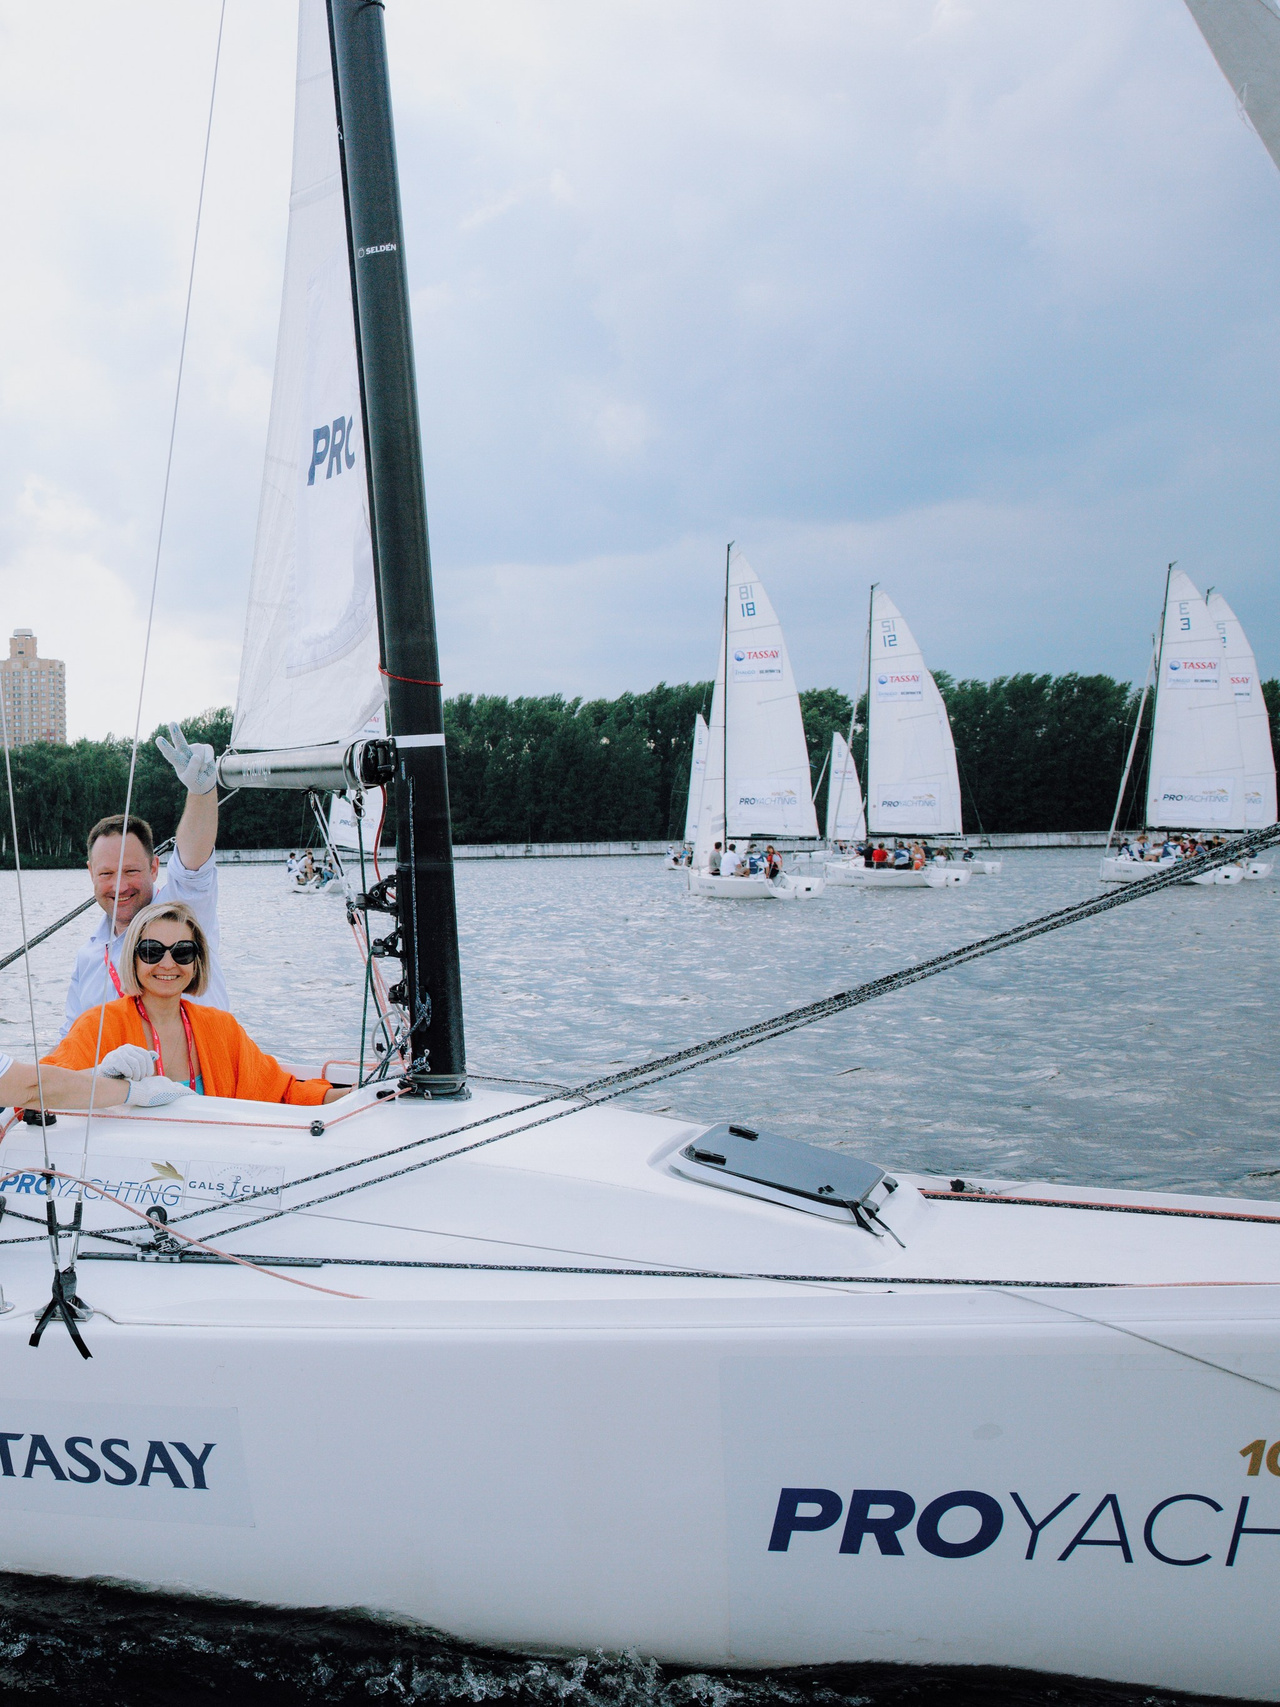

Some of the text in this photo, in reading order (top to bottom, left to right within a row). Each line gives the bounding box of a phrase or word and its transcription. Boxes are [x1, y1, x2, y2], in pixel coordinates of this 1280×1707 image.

[741, 602, 756, 617] 18
[1180, 617, 1190, 630] 3
[883, 634, 897, 647] 12
[747, 650, 779, 660] TASSAY
[1182, 662, 1218, 670] TASSAY
[889, 675, 920, 683] TASSAY
[739, 797, 797, 805] PROYACHTING
[881, 799, 936, 807] PROYACHTING
[1162, 793, 1229, 803] PROYACHTING
[188, 1181, 225, 1191] GALS
